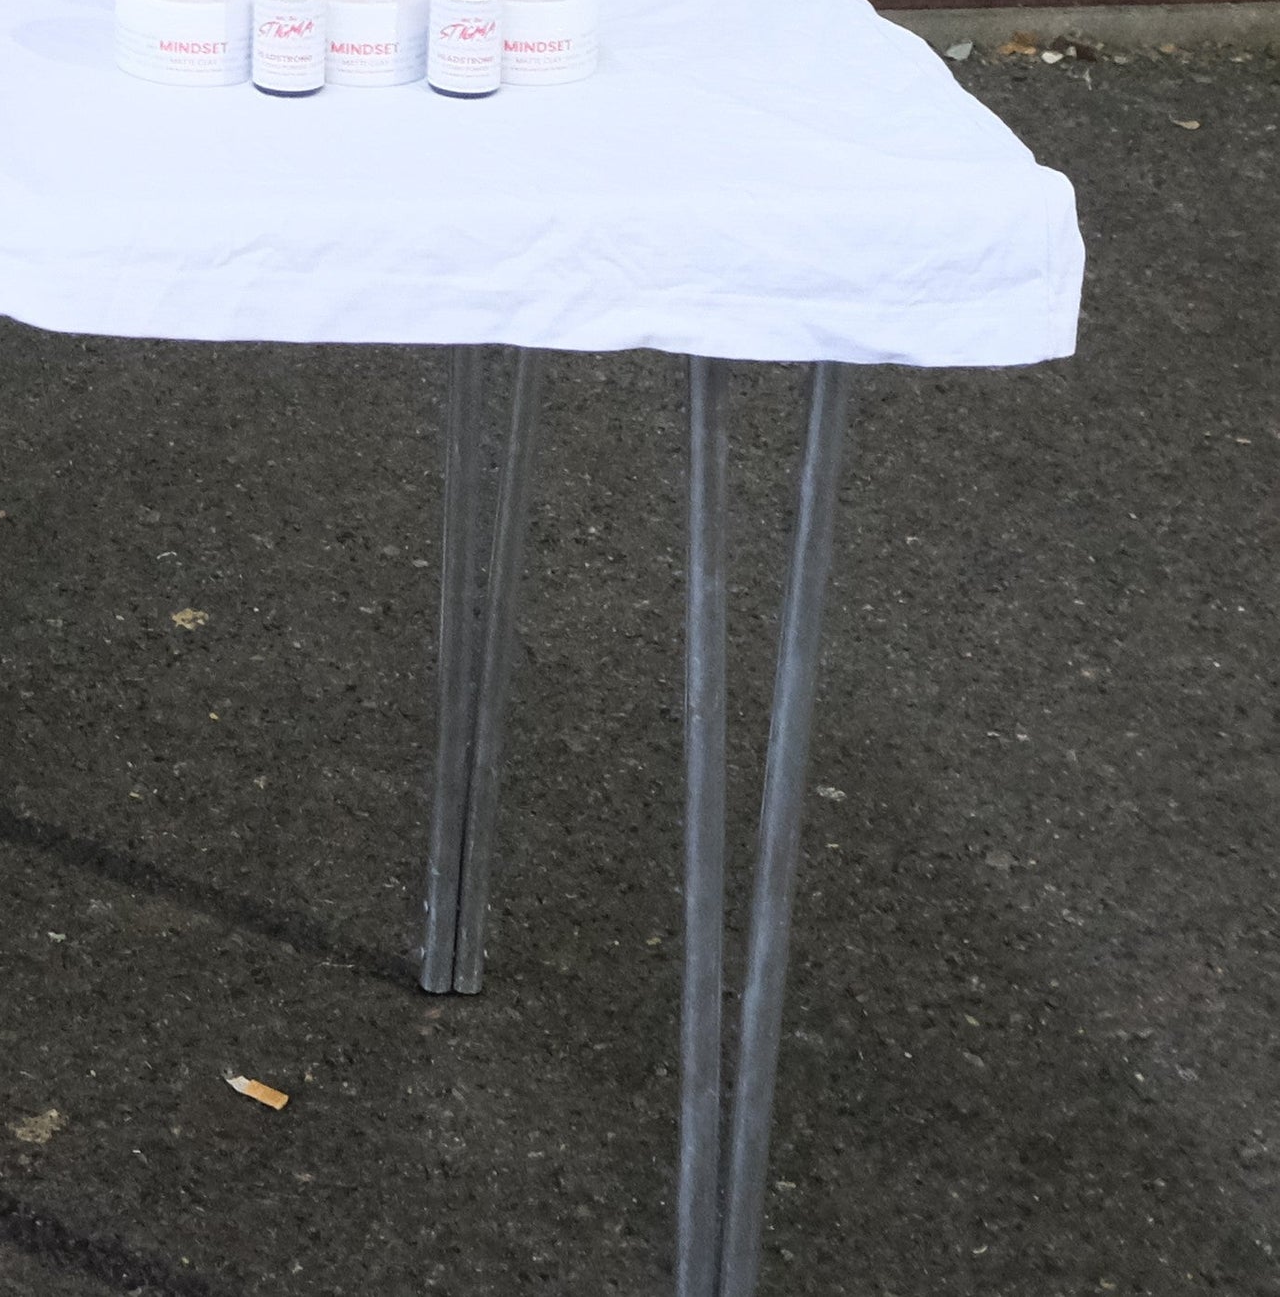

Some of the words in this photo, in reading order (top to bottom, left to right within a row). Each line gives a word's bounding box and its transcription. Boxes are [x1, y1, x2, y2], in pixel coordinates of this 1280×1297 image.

[159, 39, 230, 55] MINDSET
[330, 41, 400, 56] MINDSET
[503, 38, 572, 54] MINDSET
